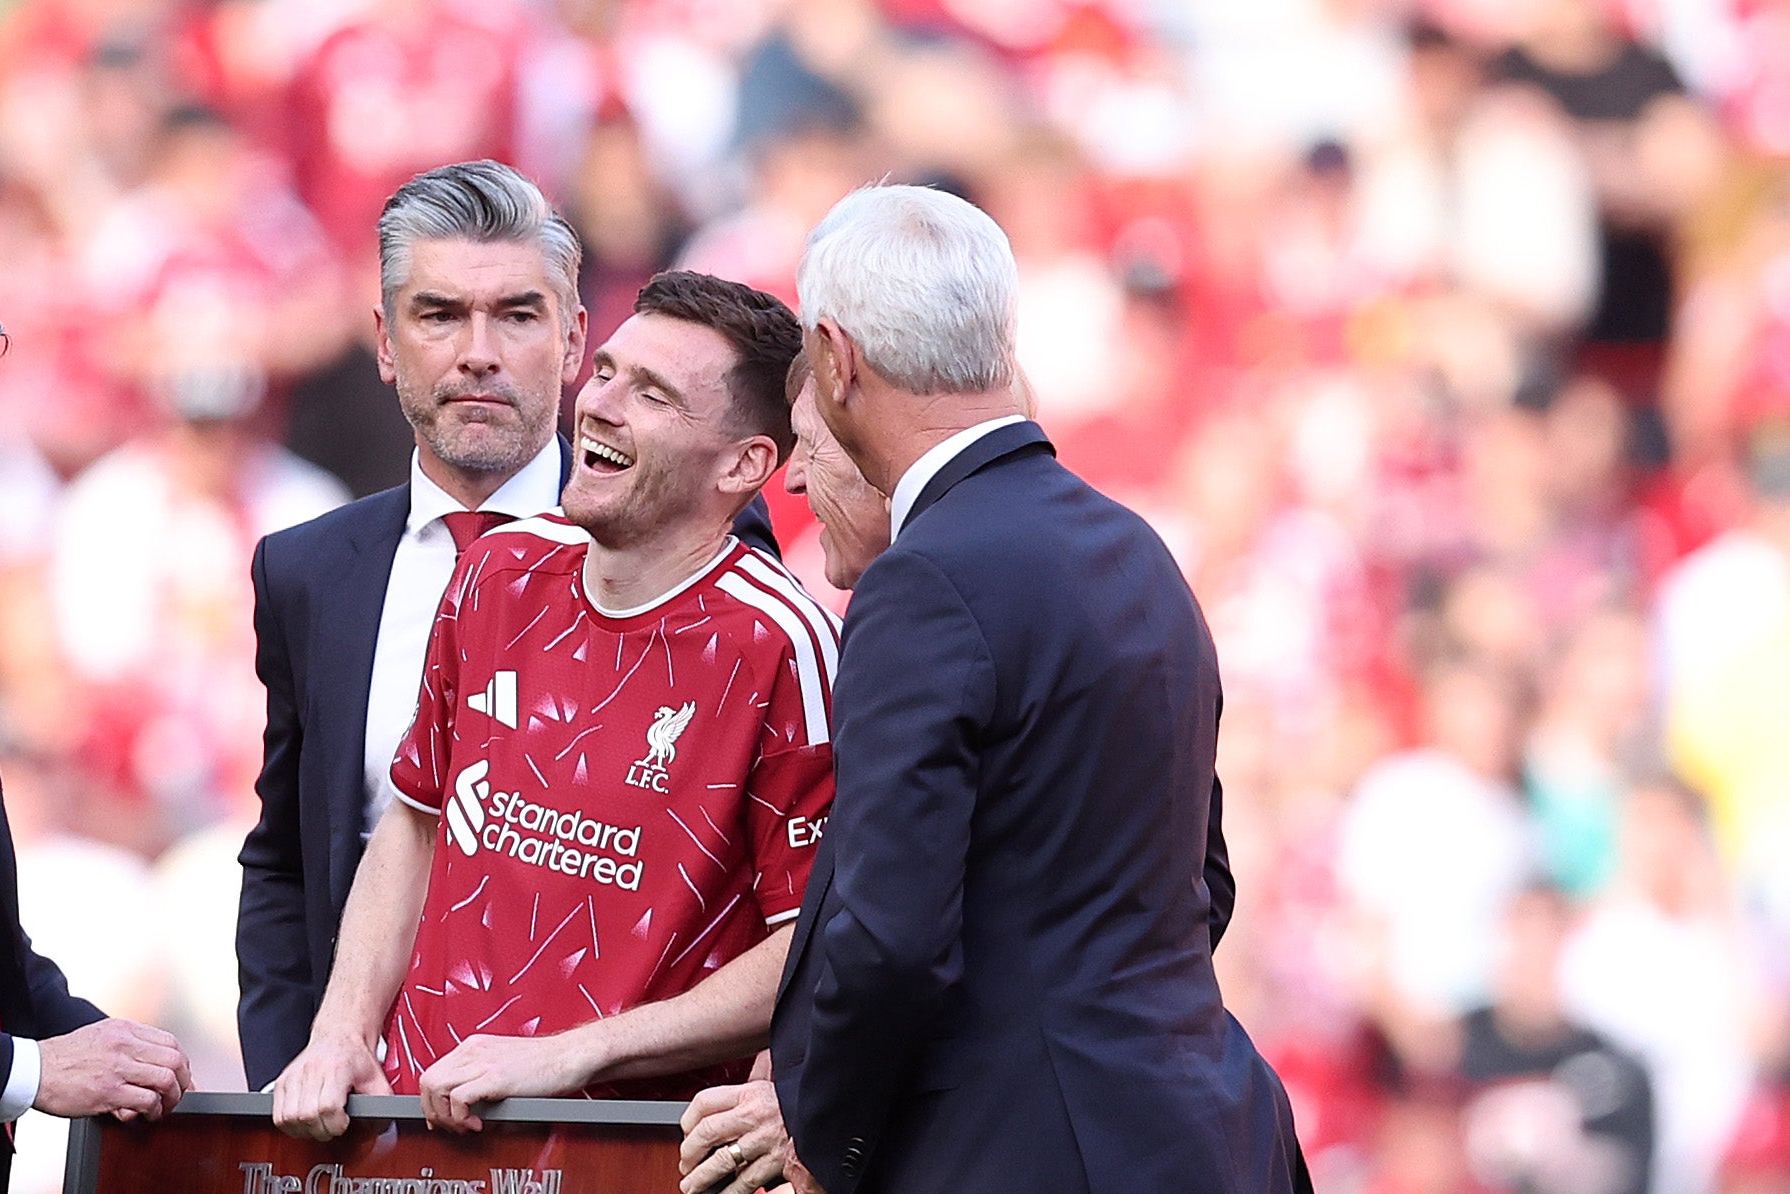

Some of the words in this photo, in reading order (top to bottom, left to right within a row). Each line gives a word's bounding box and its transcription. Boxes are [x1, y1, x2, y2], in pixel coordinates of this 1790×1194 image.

[624, 765, 670, 794] L.F.C.
[488, 791, 642, 857] standard
[787, 816, 829, 848] Ex
[482, 822, 644, 891] chartered
